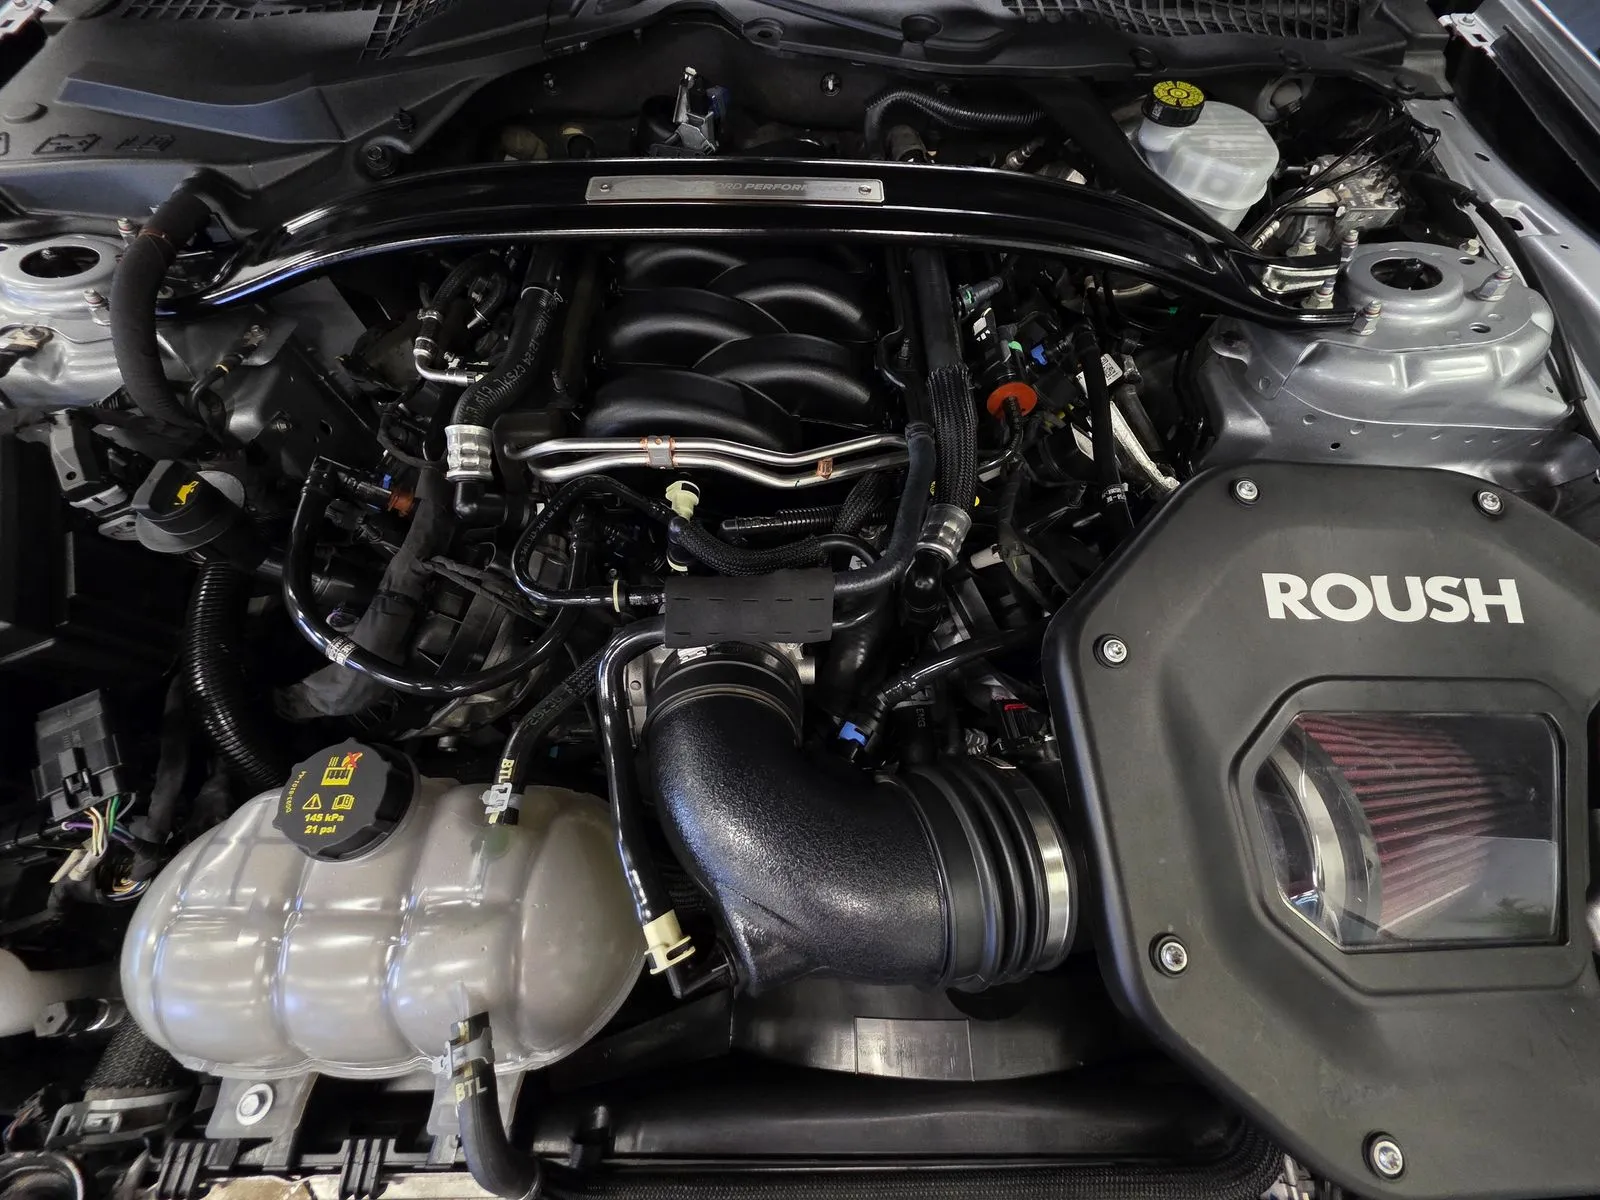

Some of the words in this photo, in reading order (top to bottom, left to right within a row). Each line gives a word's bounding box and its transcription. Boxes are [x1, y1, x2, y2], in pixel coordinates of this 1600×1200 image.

[709, 181, 742, 191] ORD
[744, 182, 852, 193] PERFORM
[1262, 573, 1525, 624] ROUSH
[915, 708, 926, 728] ENG
[498, 758, 515, 784] BTL
[304, 813, 322, 822] 145
[324, 813, 345, 822] kPa
[304, 825, 318, 834] 21
[319, 825, 337, 836] psi
[455, 1076, 488, 1104] BTL
